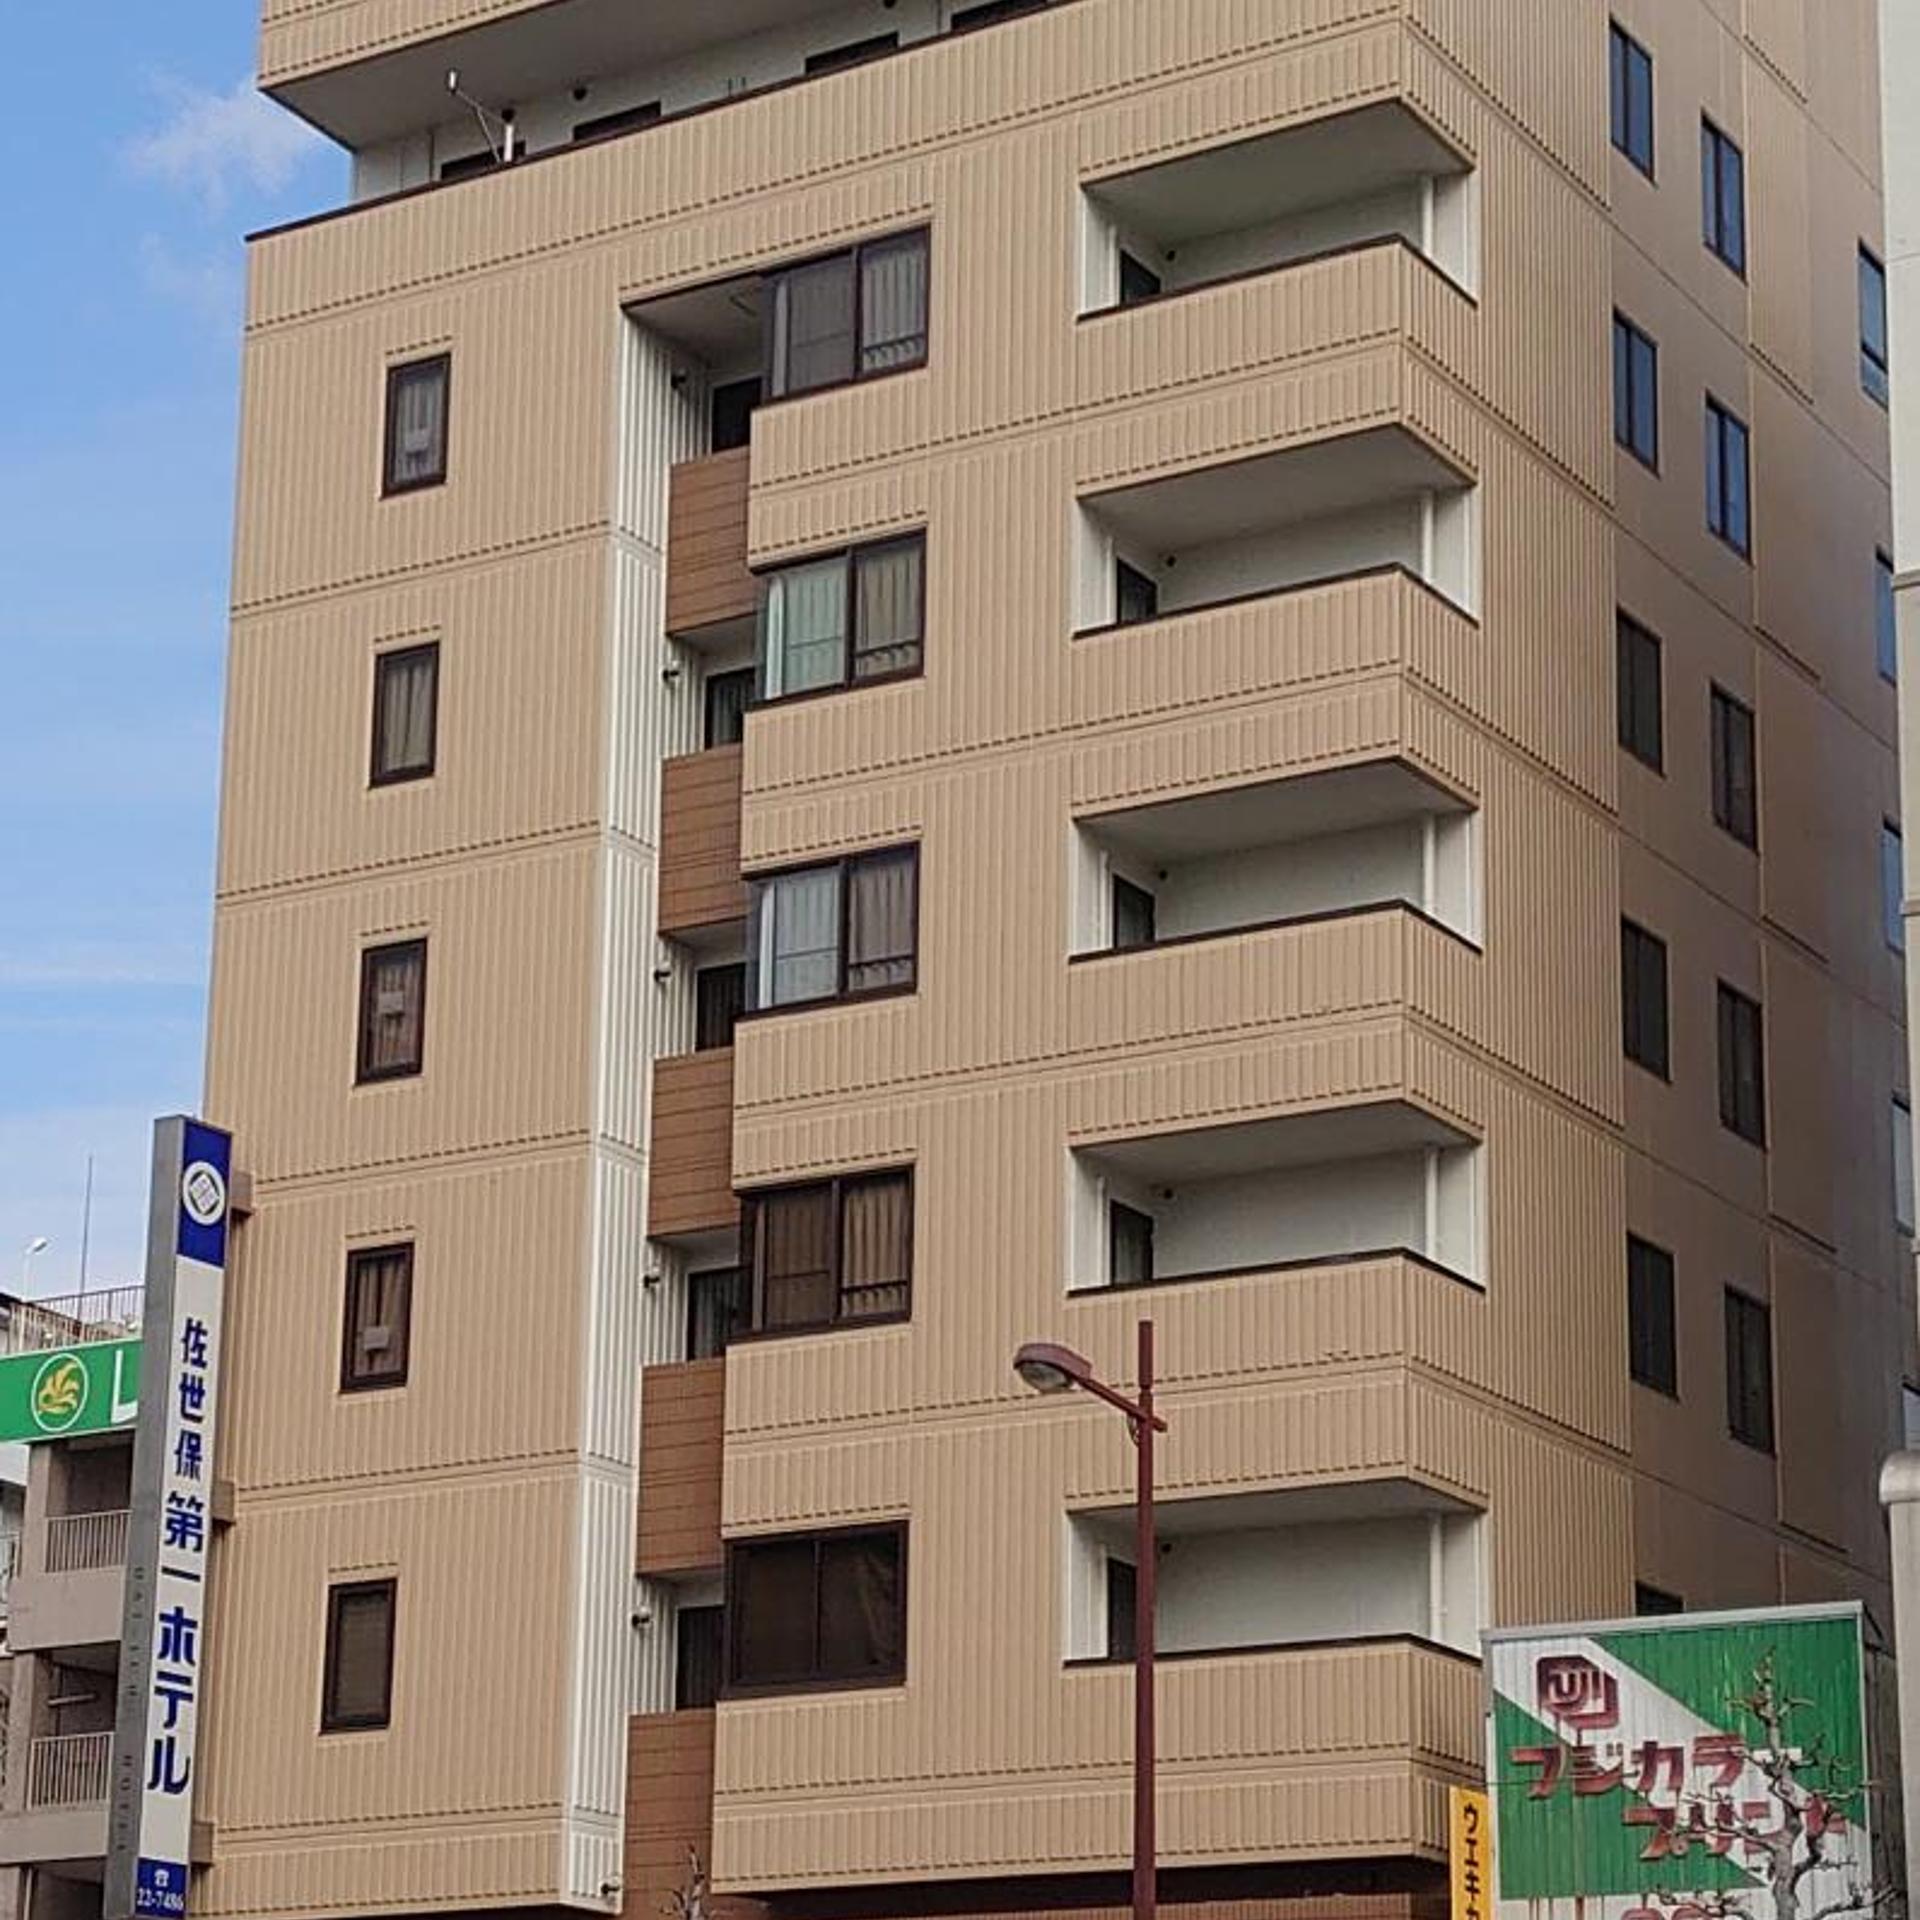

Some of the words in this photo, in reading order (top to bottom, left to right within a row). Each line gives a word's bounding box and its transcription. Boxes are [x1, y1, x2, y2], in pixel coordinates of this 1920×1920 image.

[147, 1318, 208, 1796] 佐世保第一ホテル
